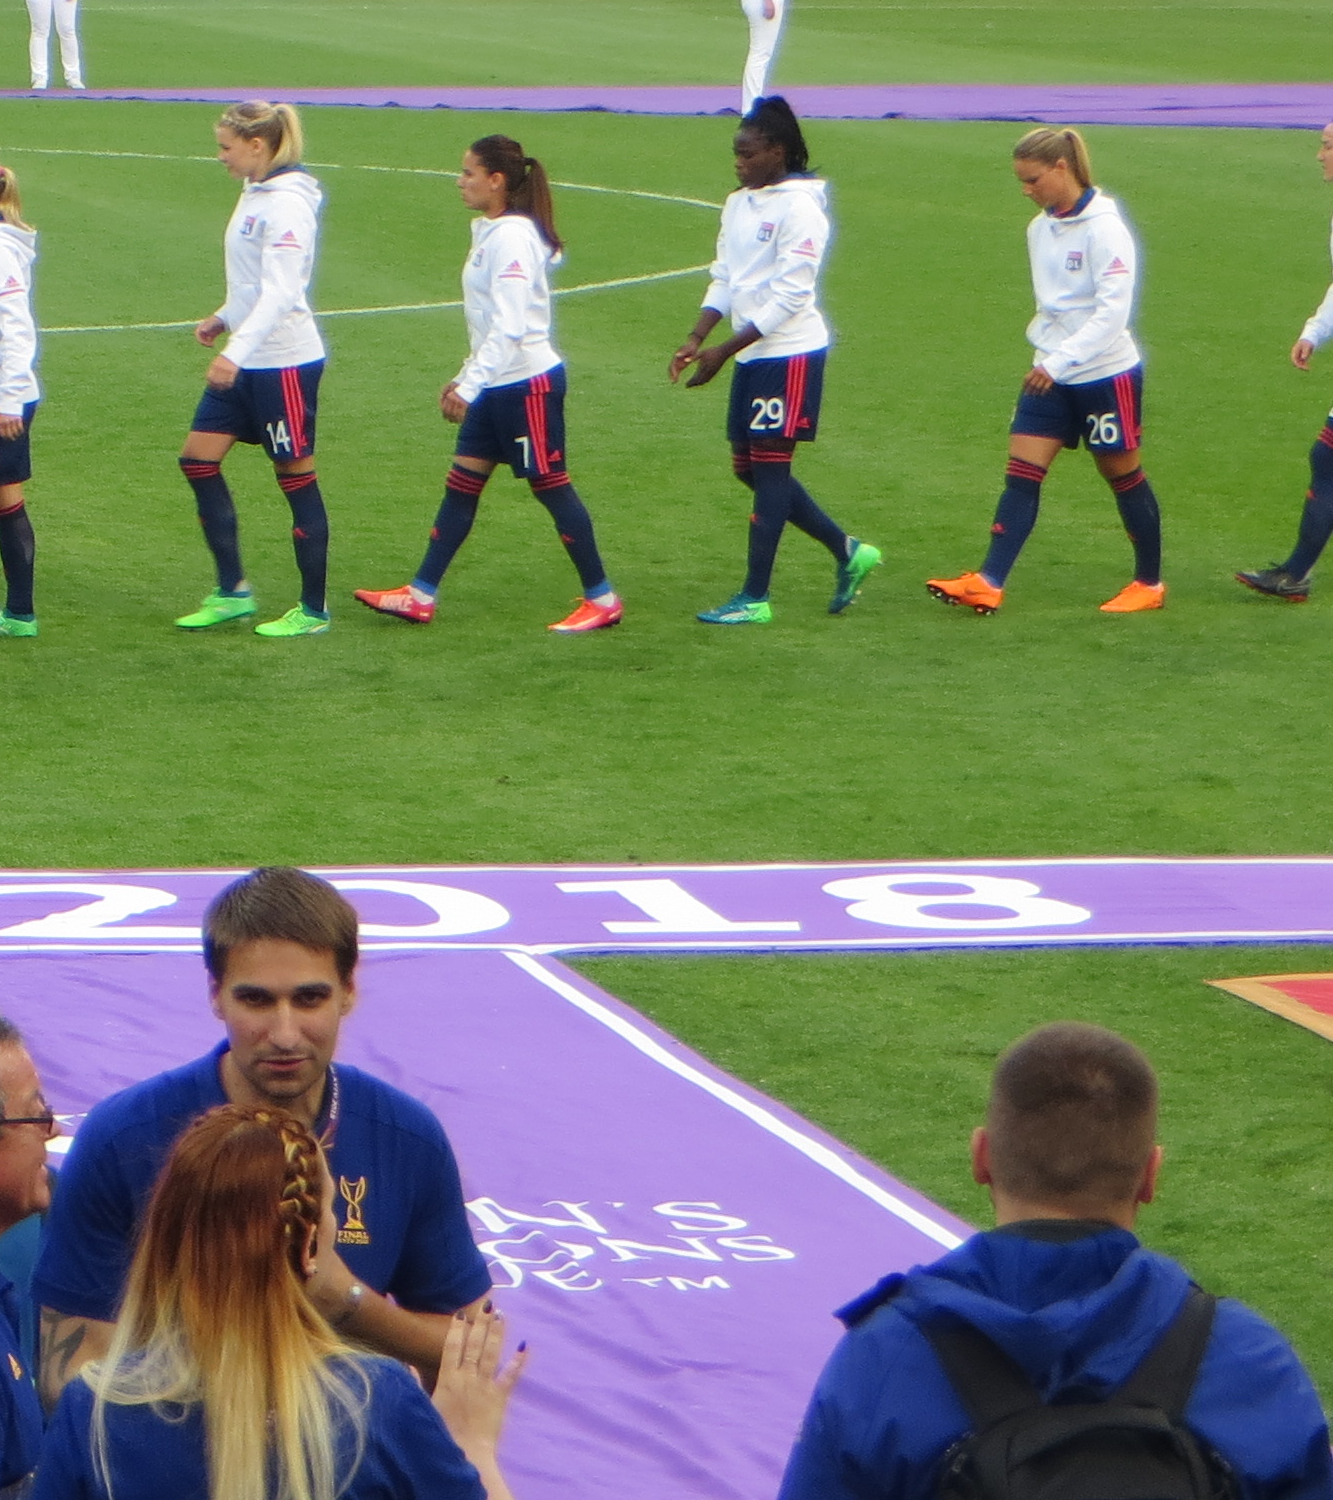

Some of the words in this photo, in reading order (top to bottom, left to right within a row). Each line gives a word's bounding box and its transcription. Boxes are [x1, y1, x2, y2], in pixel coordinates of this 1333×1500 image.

[748, 396, 785, 431] 29
[1087, 412, 1119, 446] 26
[265, 419, 292, 455] 14
[513, 435, 530, 470] 7
[337, 1230, 369, 1240] FINAL
